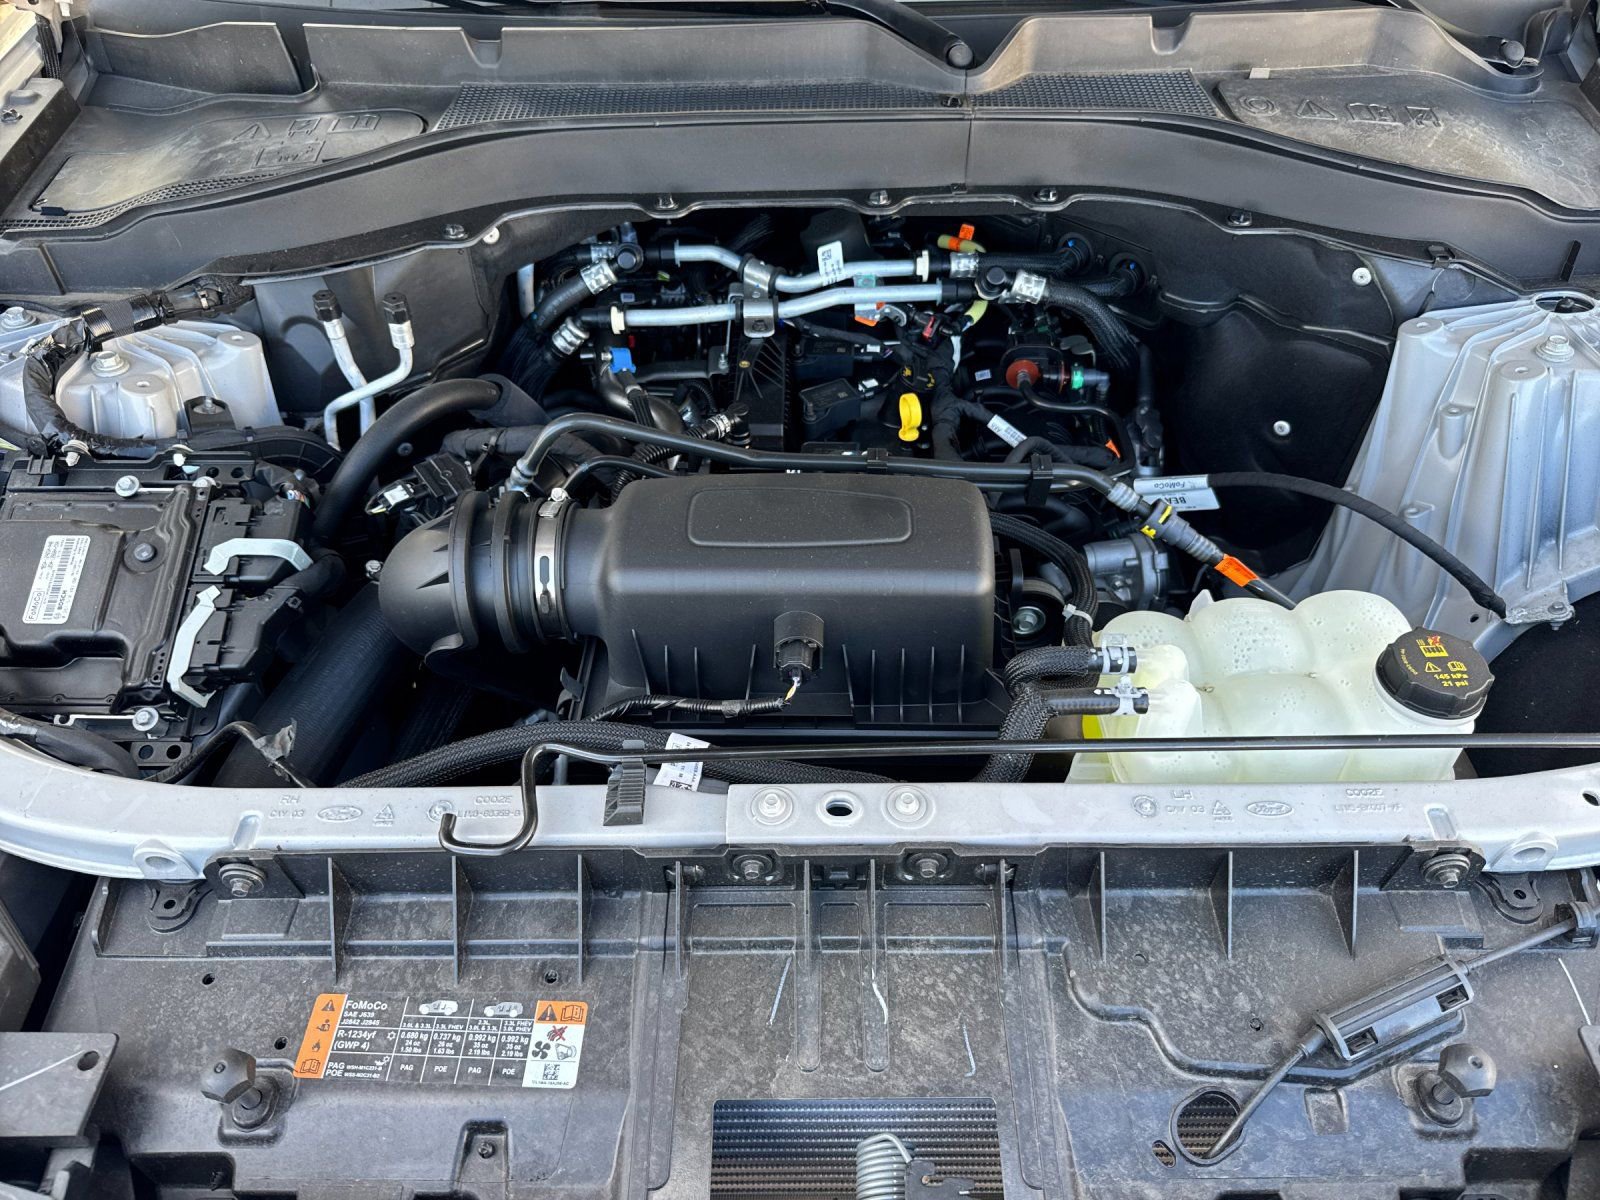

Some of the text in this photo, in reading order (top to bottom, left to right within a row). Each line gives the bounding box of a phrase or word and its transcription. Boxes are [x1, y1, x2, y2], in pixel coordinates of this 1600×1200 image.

[1154, 481, 1186, 489] FoMoCo
[57, 590, 67, 610] BOSCH
[28, 592, 43, 620] FoMoCo
[1454, 680, 1469, 688] psi
[345, 1000, 388, 1011] FoMoCo
[337, 1029, 378, 1040] R-1234yf
[400, 1031, 429, 1042] 0.680 kg
[433, 1032, 462, 1043] 0.737 kg
[468, 1033, 497, 1044] 0.992 kg
[501, 1035, 530, 1045] 0.992 kg
[333, 1041, 370, 1051] (GWP 4)
[473, 1041, 481, 1049] 35
[327, 1061, 345, 1070] PAG
[400, 1063, 414, 1071] PAG
[433, 1065, 448, 1073] POE
[467, 1066, 482, 1074] PAG
[325, 1069, 345, 1077] POE
[502, 1068, 516, 1076] POE
